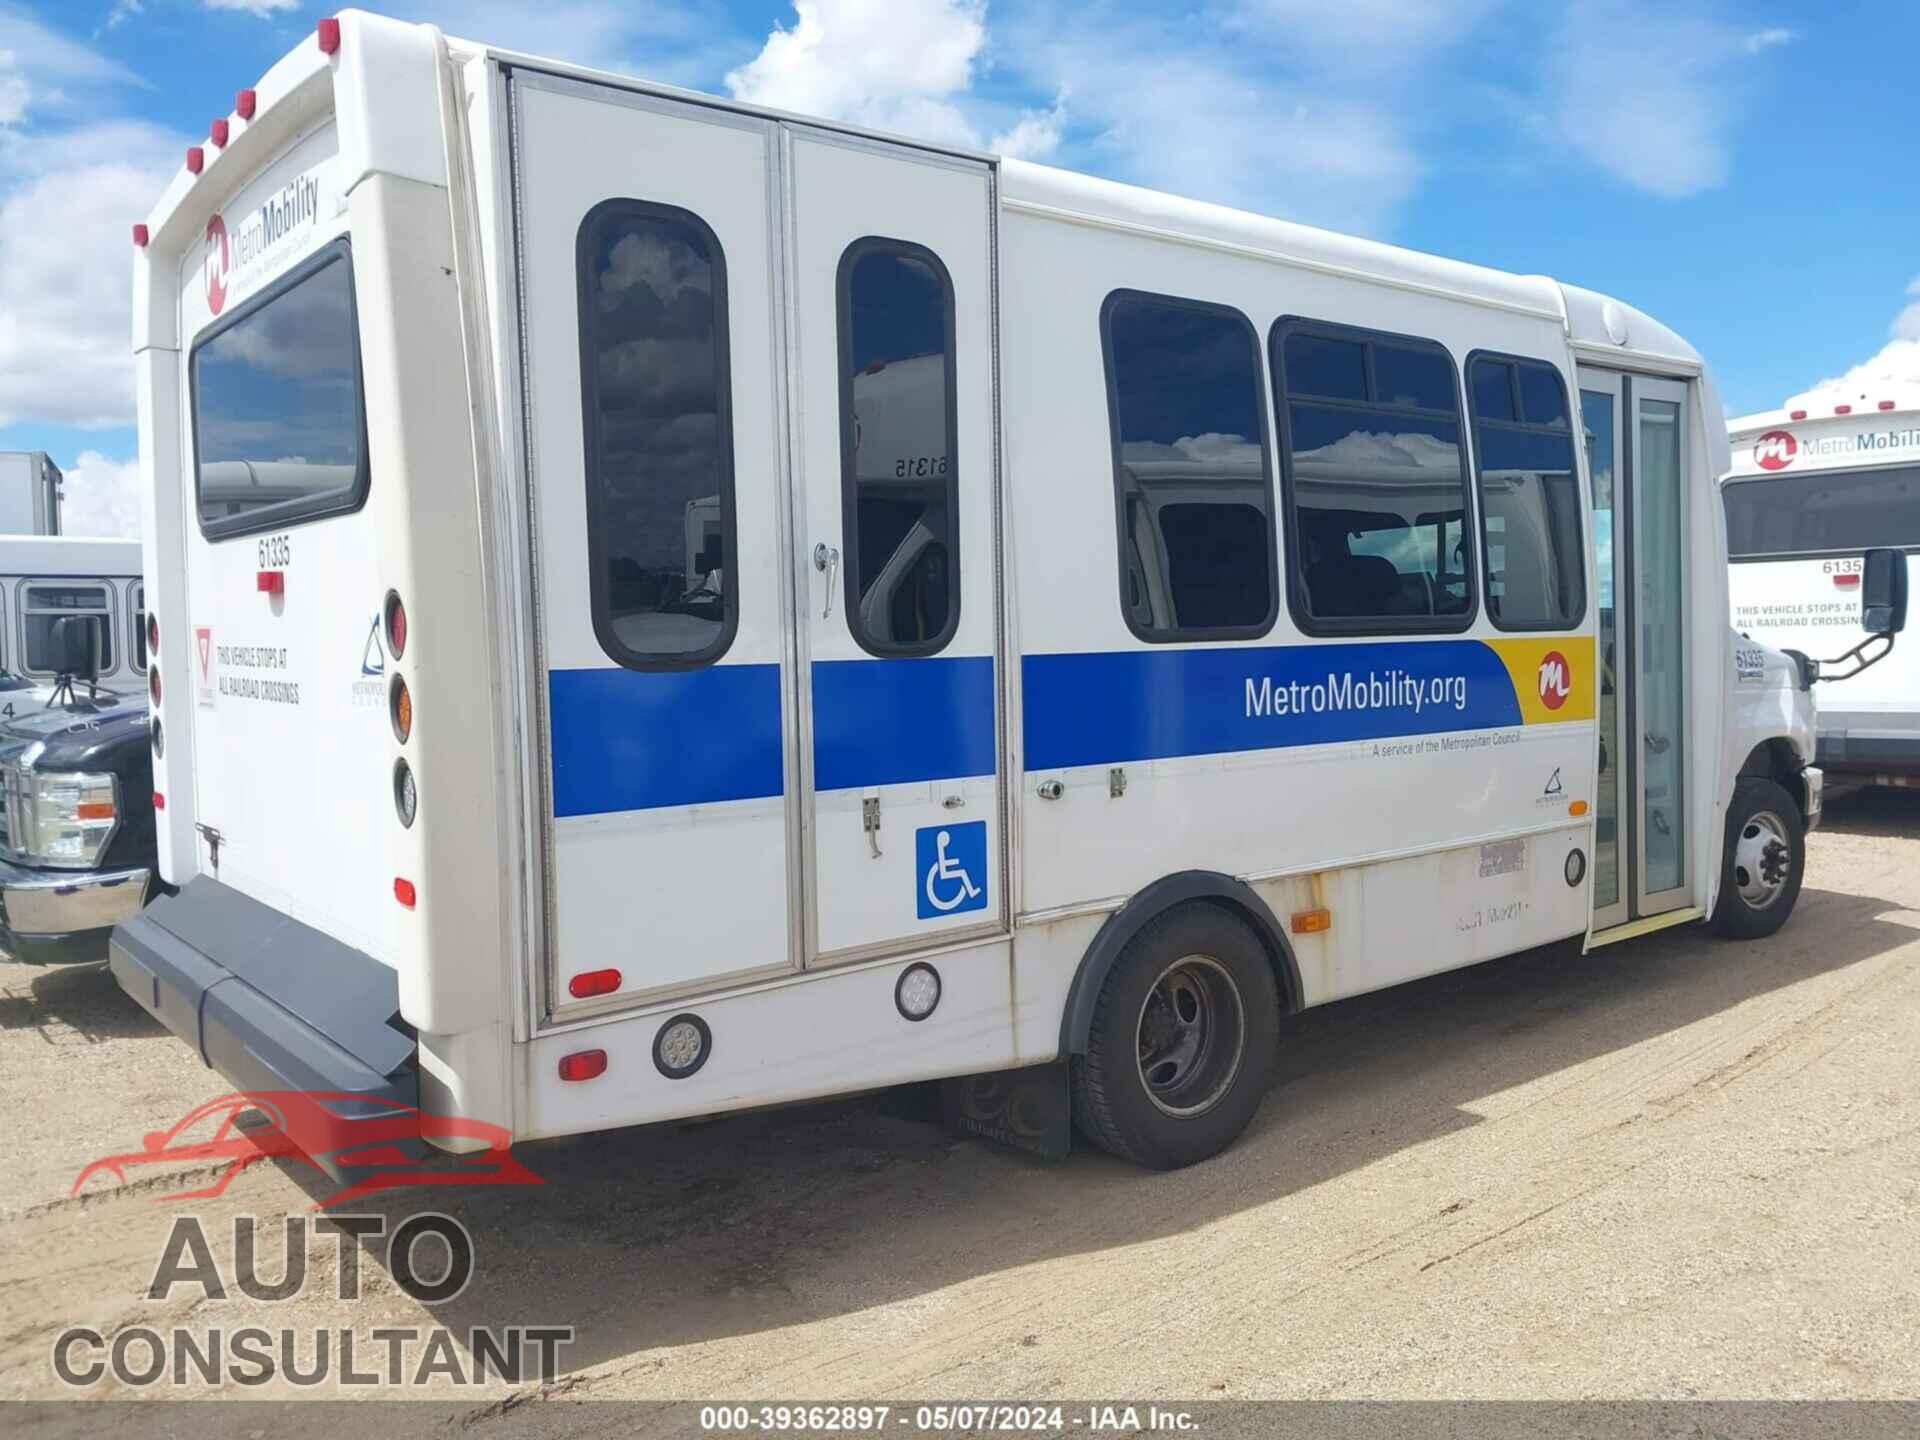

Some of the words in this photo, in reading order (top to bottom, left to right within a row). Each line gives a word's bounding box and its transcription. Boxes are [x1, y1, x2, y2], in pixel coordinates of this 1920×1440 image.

[231, 176, 319, 272] MetroMobility
[258, 535, 290, 568] 61335
[1823, 560, 1863, 574] 6135
[1736, 606, 1759, 615] THIS
[1762, 604, 1802, 614] VEHICLE
[1807, 603, 1841, 613] STOPS
[1845, 602, 1858, 612] AT
[1736, 619, 1753, 628] ALL
[1756, 617, 1808, 627] RAILROAD
[217, 646, 230, 665] THIS
[231, 646, 255, 667] VEHICLE
[256, 647, 277, 669] STOPS
[279, 647, 287, 669] AT
[219, 676, 229, 695] ALL
[229, 676, 259, 700] RAILROAD
[260, 679, 299, 704] CROSSINGS
[1244, 670, 1468, 718] MetroMobility.org
[2, 702, 15, 718] 4
[1372, 744, 1380, 758] A
[1381, 745, 1413, 757] service
[1415, 741, 1424, 754] of
[1425, 740, 1440, 753] the
[1441, 734, 1491, 751] Metropolitan
[1493, 731, 1520, 746] Council
